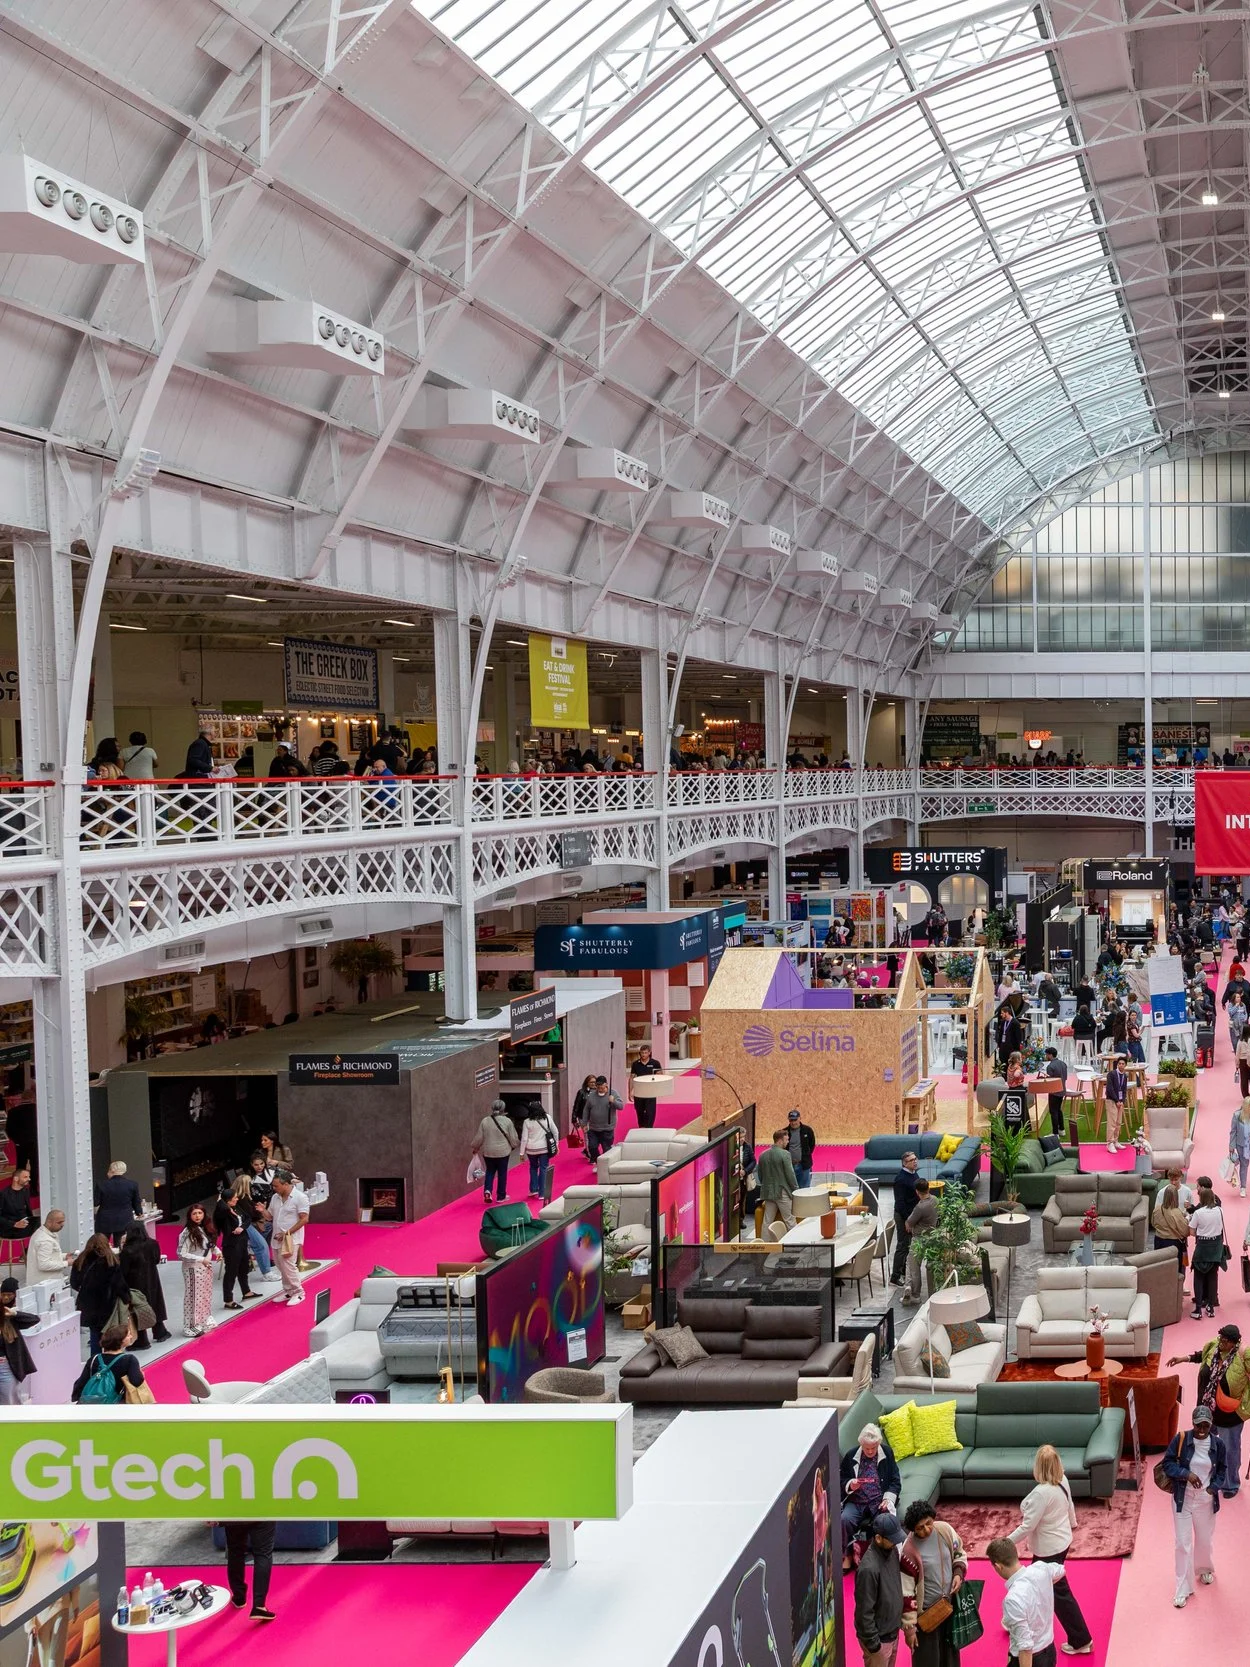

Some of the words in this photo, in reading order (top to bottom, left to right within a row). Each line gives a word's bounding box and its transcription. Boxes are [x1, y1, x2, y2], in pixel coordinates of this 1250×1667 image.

[295, 652, 314, 676] THE
[317, 654, 348, 679] GREEK
[350, 658, 368, 682] BOX
[544, 661, 553, 671] EAT
[554, 662, 558, 671] &
[559, 663, 575, 674] DRINK
[548, 673, 571, 684] FESTIVAL
[318, 682, 334, 694] STREET
[1142, 731, 1195, 739] LBANESE
[1166, 837, 1195, 850] TH
[915, 852, 982, 863] SHUTTERS
[1113, 871, 1153, 880] Roland
[512, 1003, 529, 1017] FLAMES
[535, 994, 555, 1008] RICHMOND
[514, 1020, 532, 1031] Fireplaces
[534, 1016, 542, 1024] Fires
[780, 1030, 854, 1052] Selina
[296, 1062, 330, 1070] FLAMES
[343, 1062, 392, 1070] RICHMOND
[39, 1326, 77, 1349] OPATRA
[10, 1438, 255, 1501] Gtech
